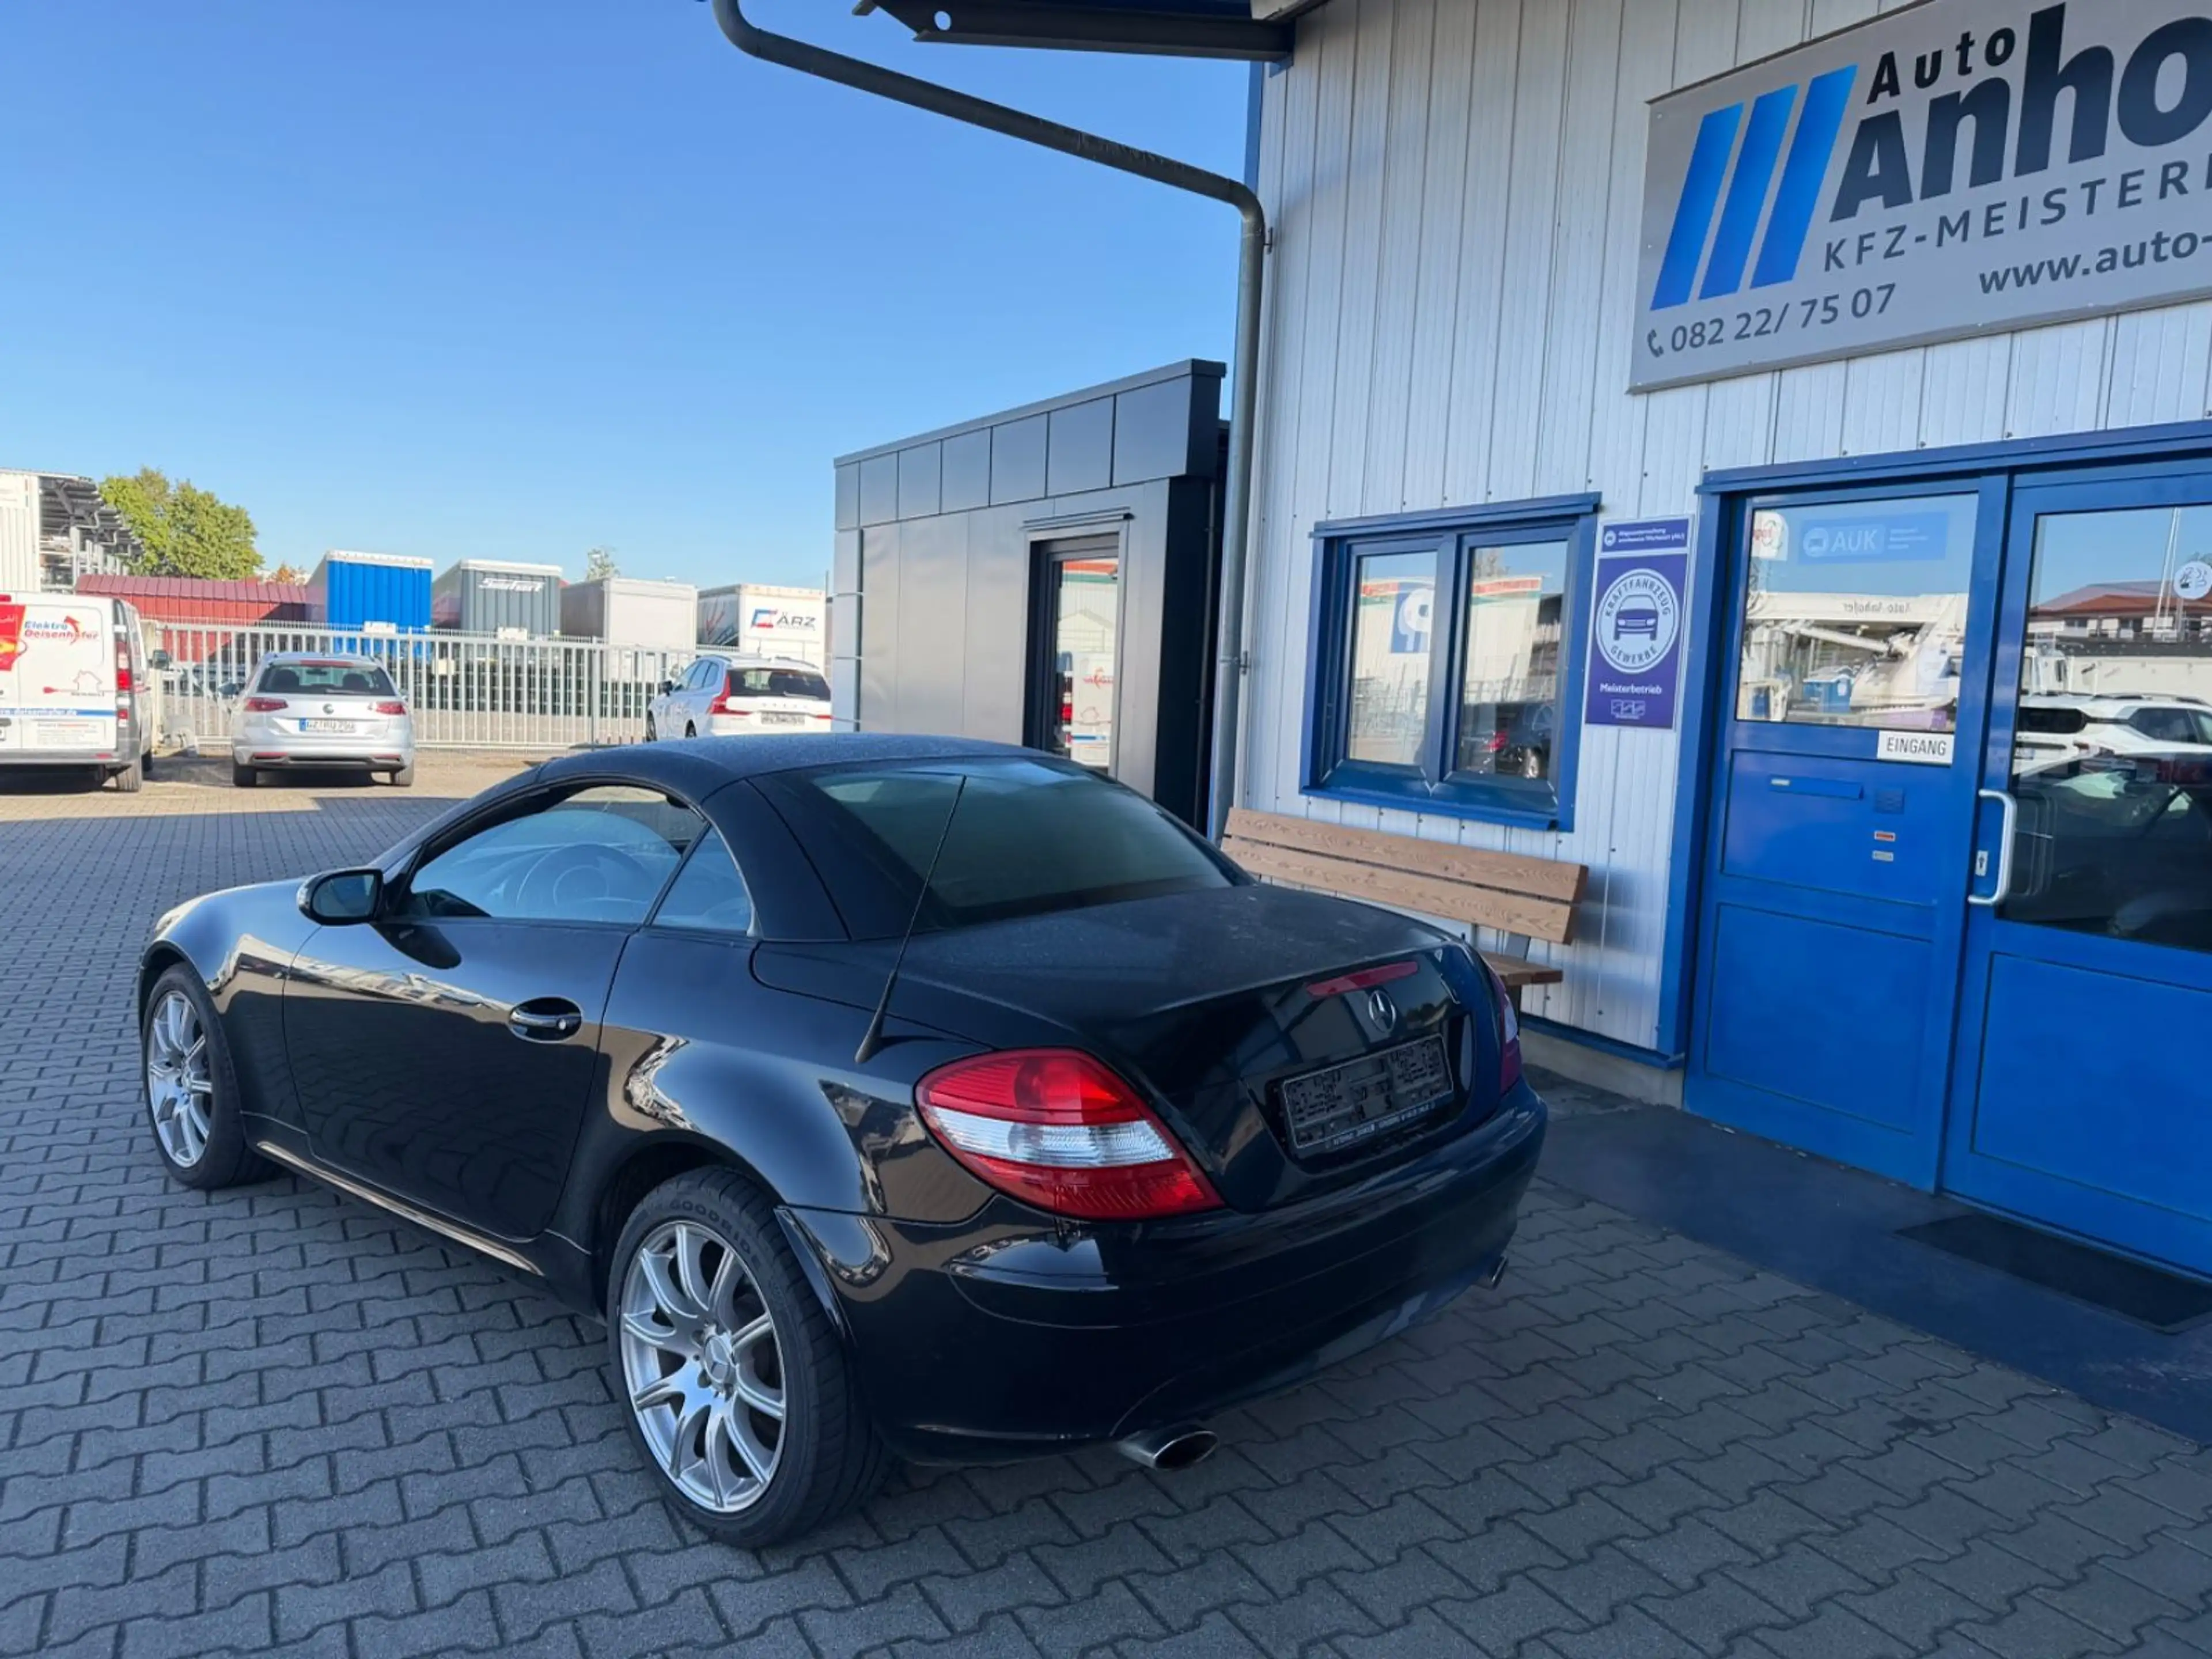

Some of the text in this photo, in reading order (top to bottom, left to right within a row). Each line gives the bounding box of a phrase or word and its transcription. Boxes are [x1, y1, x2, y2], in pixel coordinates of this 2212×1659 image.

[1866, 28, 2016, 104] Auto
[1824, 154, 2212, 272] KFZ-MEISTER
[1979, 231, 2212, 294] www.auto-
[1671, 282, 1896, 352] 082 22/ 75 07
[1831, 528, 1879, 552] AUK
[1605, 578, 1672, 616] KRAFTFAHRZEUG
[24, 620, 68, 630] Elektro
[1610, 645, 1658, 664] GEWERBE
[1599, 683, 1662, 695] Meisterbetrieb
[1886, 736, 1947, 756] EINGANG
